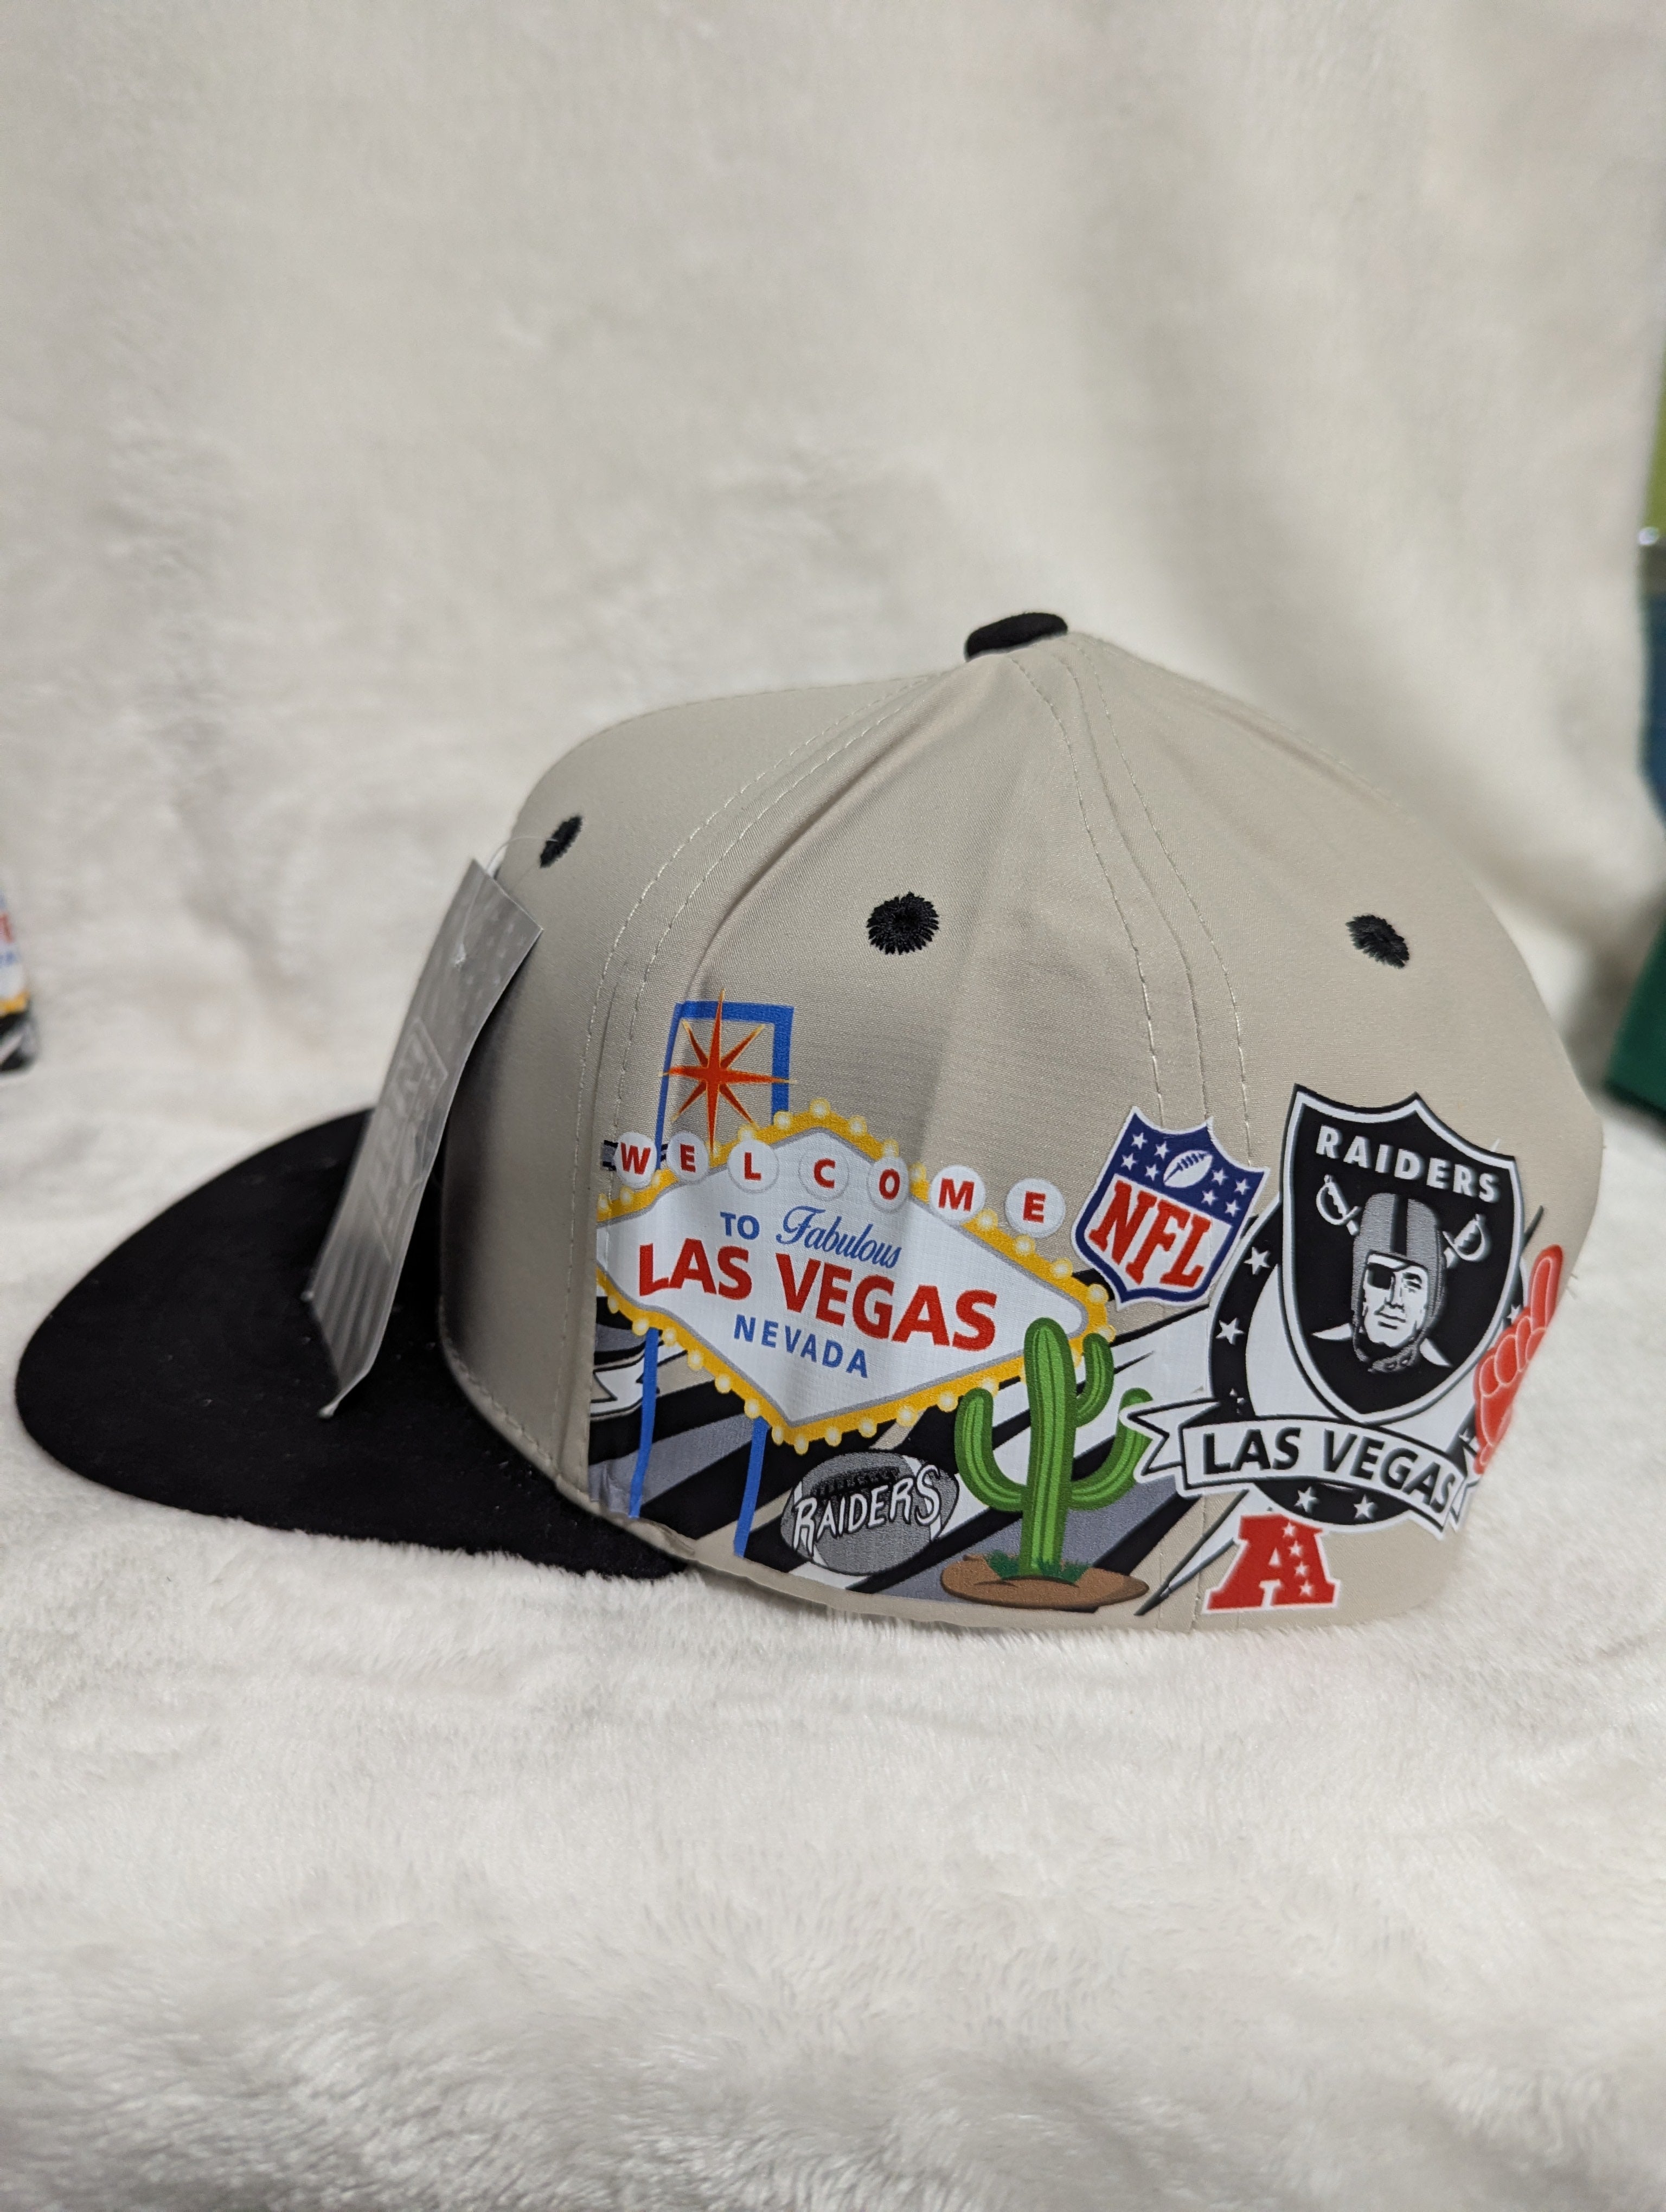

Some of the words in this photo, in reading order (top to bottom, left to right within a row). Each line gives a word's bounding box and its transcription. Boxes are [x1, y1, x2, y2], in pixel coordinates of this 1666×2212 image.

[620, 1141, 1045, 1223] WELCOME
[1316, 1124, 1502, 1204] RAIDERS
[720, 1212, 759, 1239] TO
[776, 1205, 901, 1269] Fabulous
[1088, 1180, 1214, 1289] NFL
[638, 1237, 753, 1301] LAS
[775, 1253, 998, 1352] VEGAS
[734, 1314, 868, 1379] NEVADA
[792, 1464, 942, 1557] RAIDERS
[1202, 1427, 1302, 1475] LAS
[1322, 1429, 1459, 1515] VEGAS
